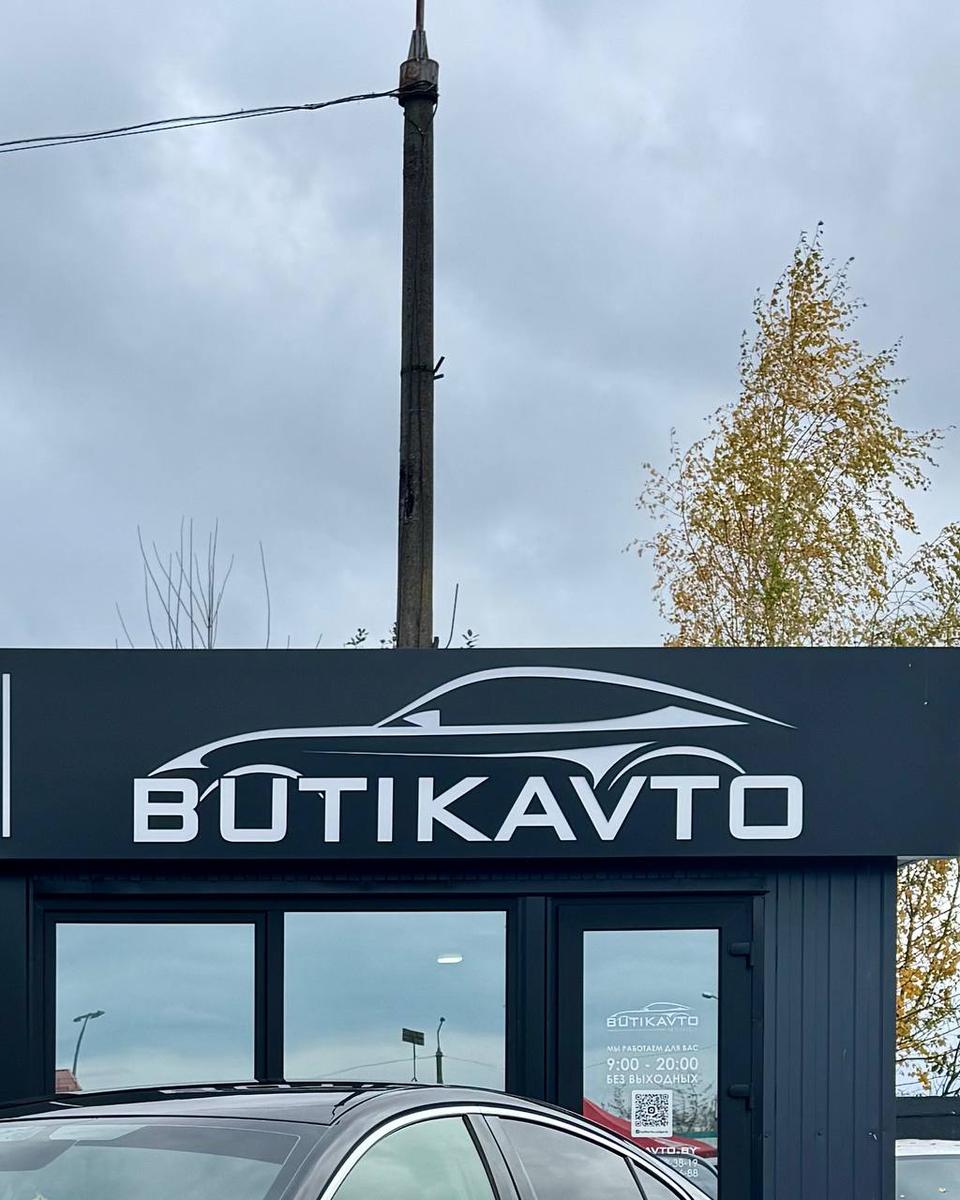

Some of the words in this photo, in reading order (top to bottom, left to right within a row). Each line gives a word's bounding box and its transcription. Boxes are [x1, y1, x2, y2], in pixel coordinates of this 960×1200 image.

[133, 774, 804, 843] BUTIKAVTO
[606, 1016, 699, 1027] BUTIKAVTO
[607, 1057, 640, 1071] 9:00
[656, 1057, 699, 1071] 20:00
[606, 1074, 625, 1084] БЕЗ
[629, 1074, 699, 1085] ВЫХОДНЫХ
[645, 1146, 701, 1155] AVTO.BY
